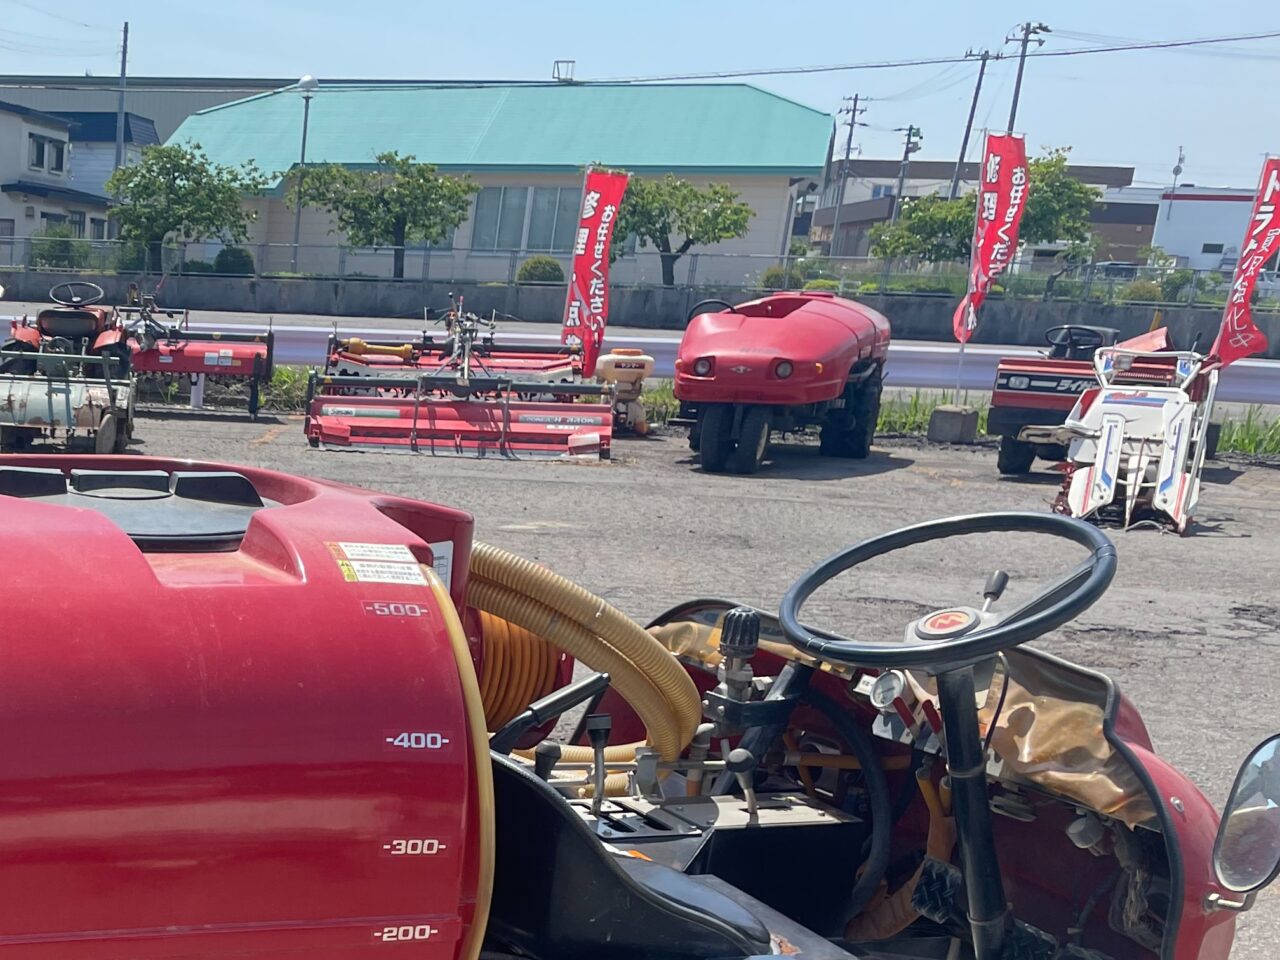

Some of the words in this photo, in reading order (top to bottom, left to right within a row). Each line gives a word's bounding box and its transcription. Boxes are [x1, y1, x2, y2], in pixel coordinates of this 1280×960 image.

[386, 732, 450, 749] -400-
[383, 839, 447, 855] -300-
[374, 925, 438, 942] -200-
